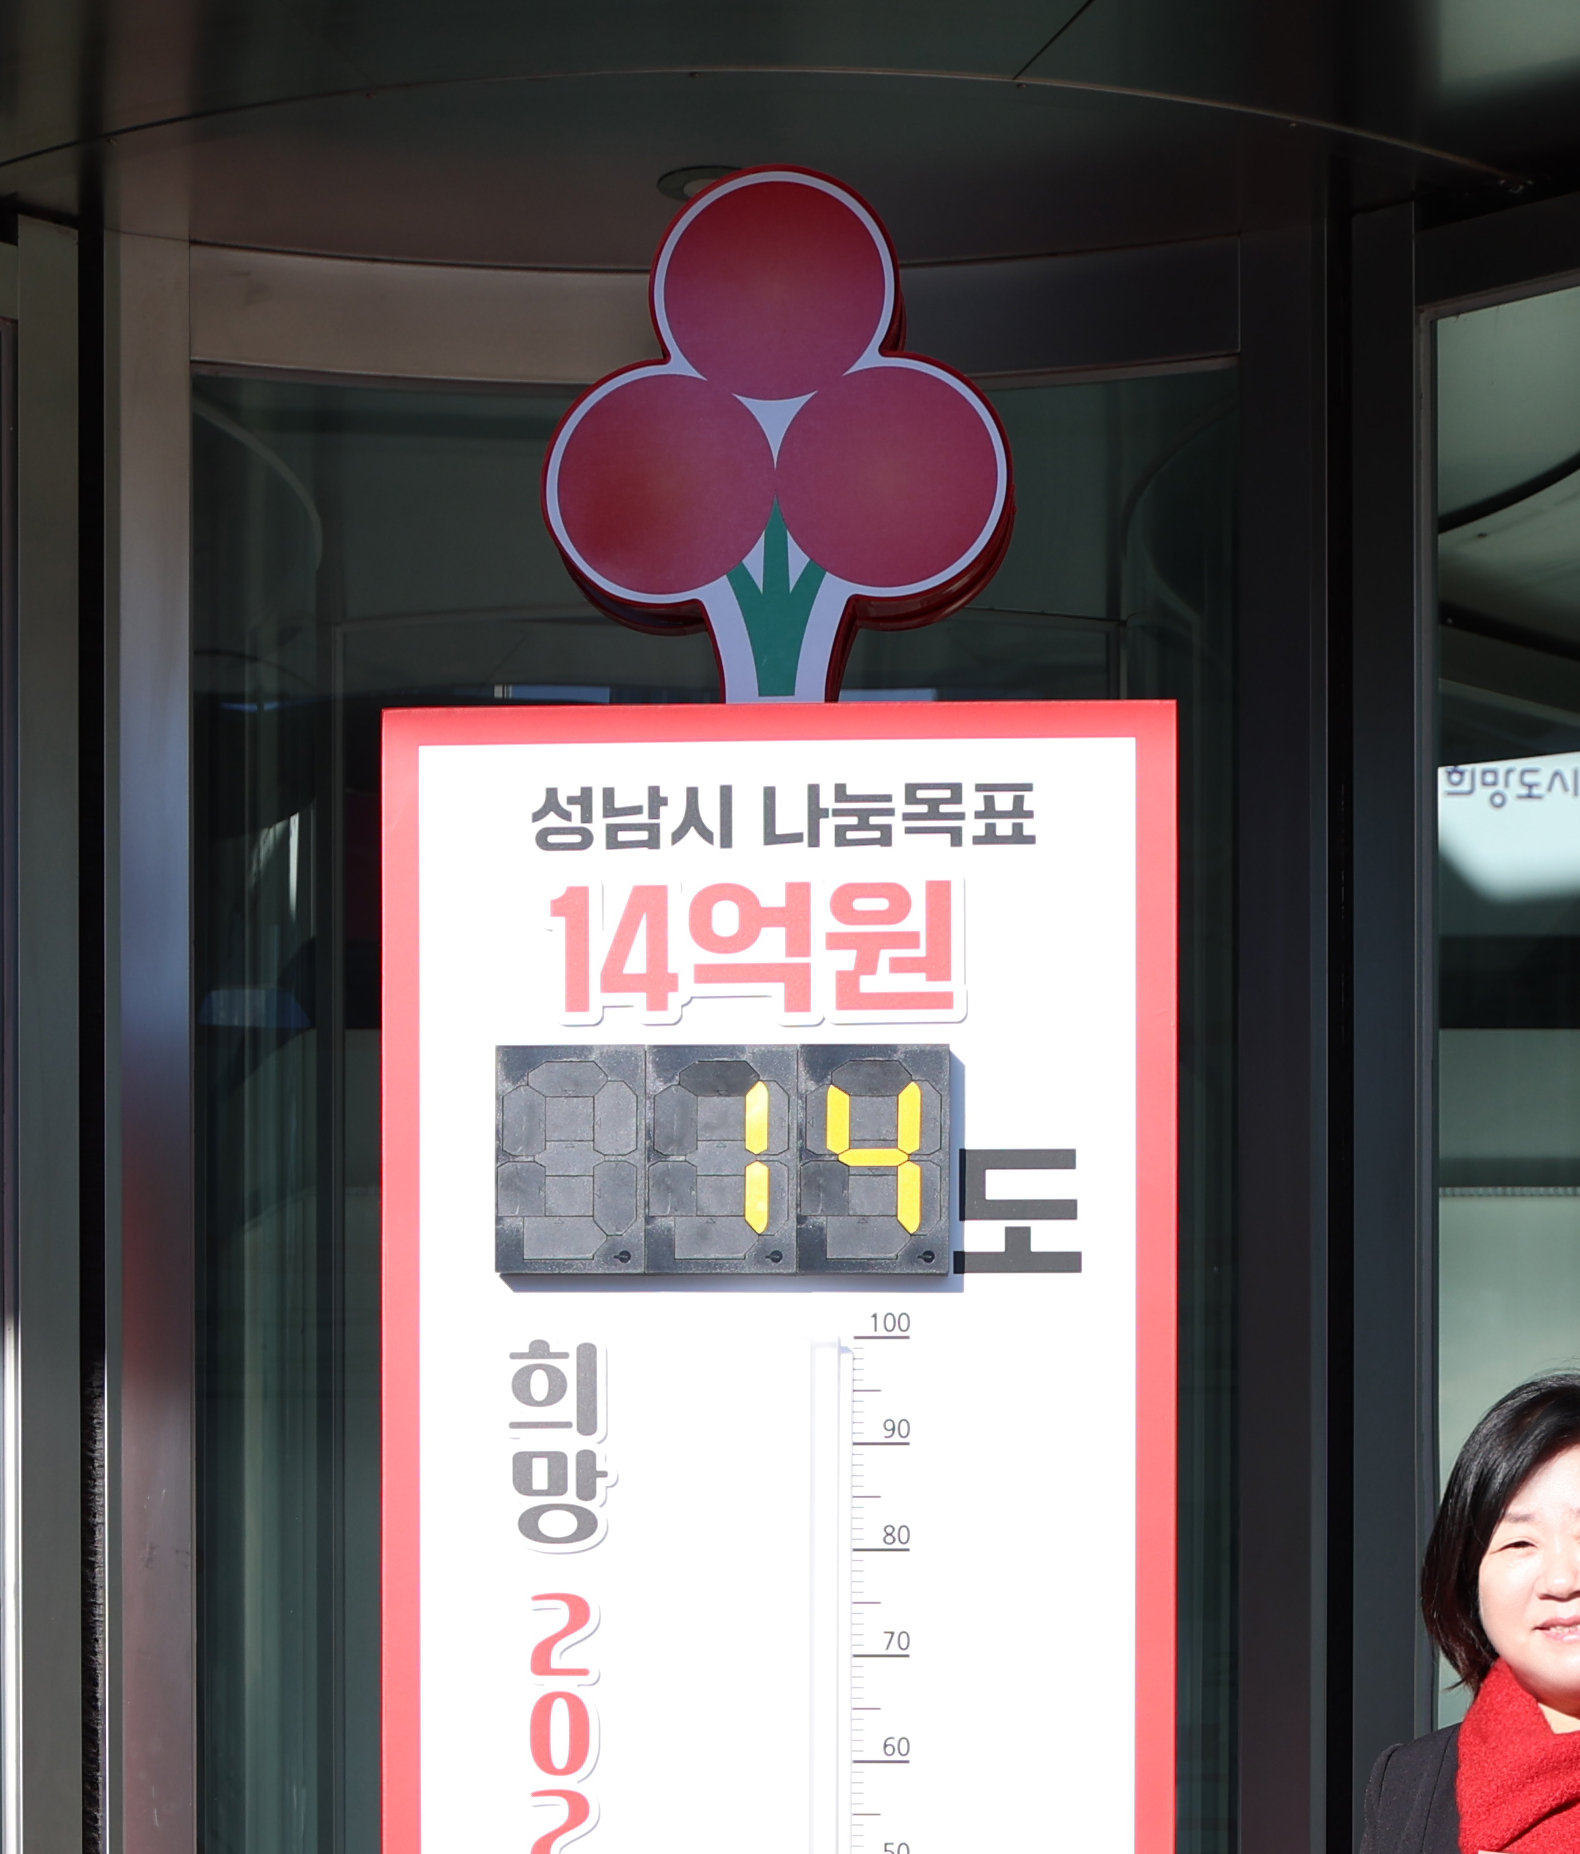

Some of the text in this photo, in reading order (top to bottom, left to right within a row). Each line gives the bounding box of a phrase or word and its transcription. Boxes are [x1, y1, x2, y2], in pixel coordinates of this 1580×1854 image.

[1444, 765, 1580, 809] 희망도시
[531, 782, 1037, 851] 성남시 나눔목표
[549, 879, 955, 1013] 14억원
[744, 1080, 1083, 1275] 14 도
[869, 1312, 911, 1333] 100
[508, 1338, 609, 1545] 희망
[882, 1418, 911, 1439] 90
[882, 1524, 911, 1546] 80
[882, 1631, 911, 1652] 70
[882, 1736, 911, 1757] 60
